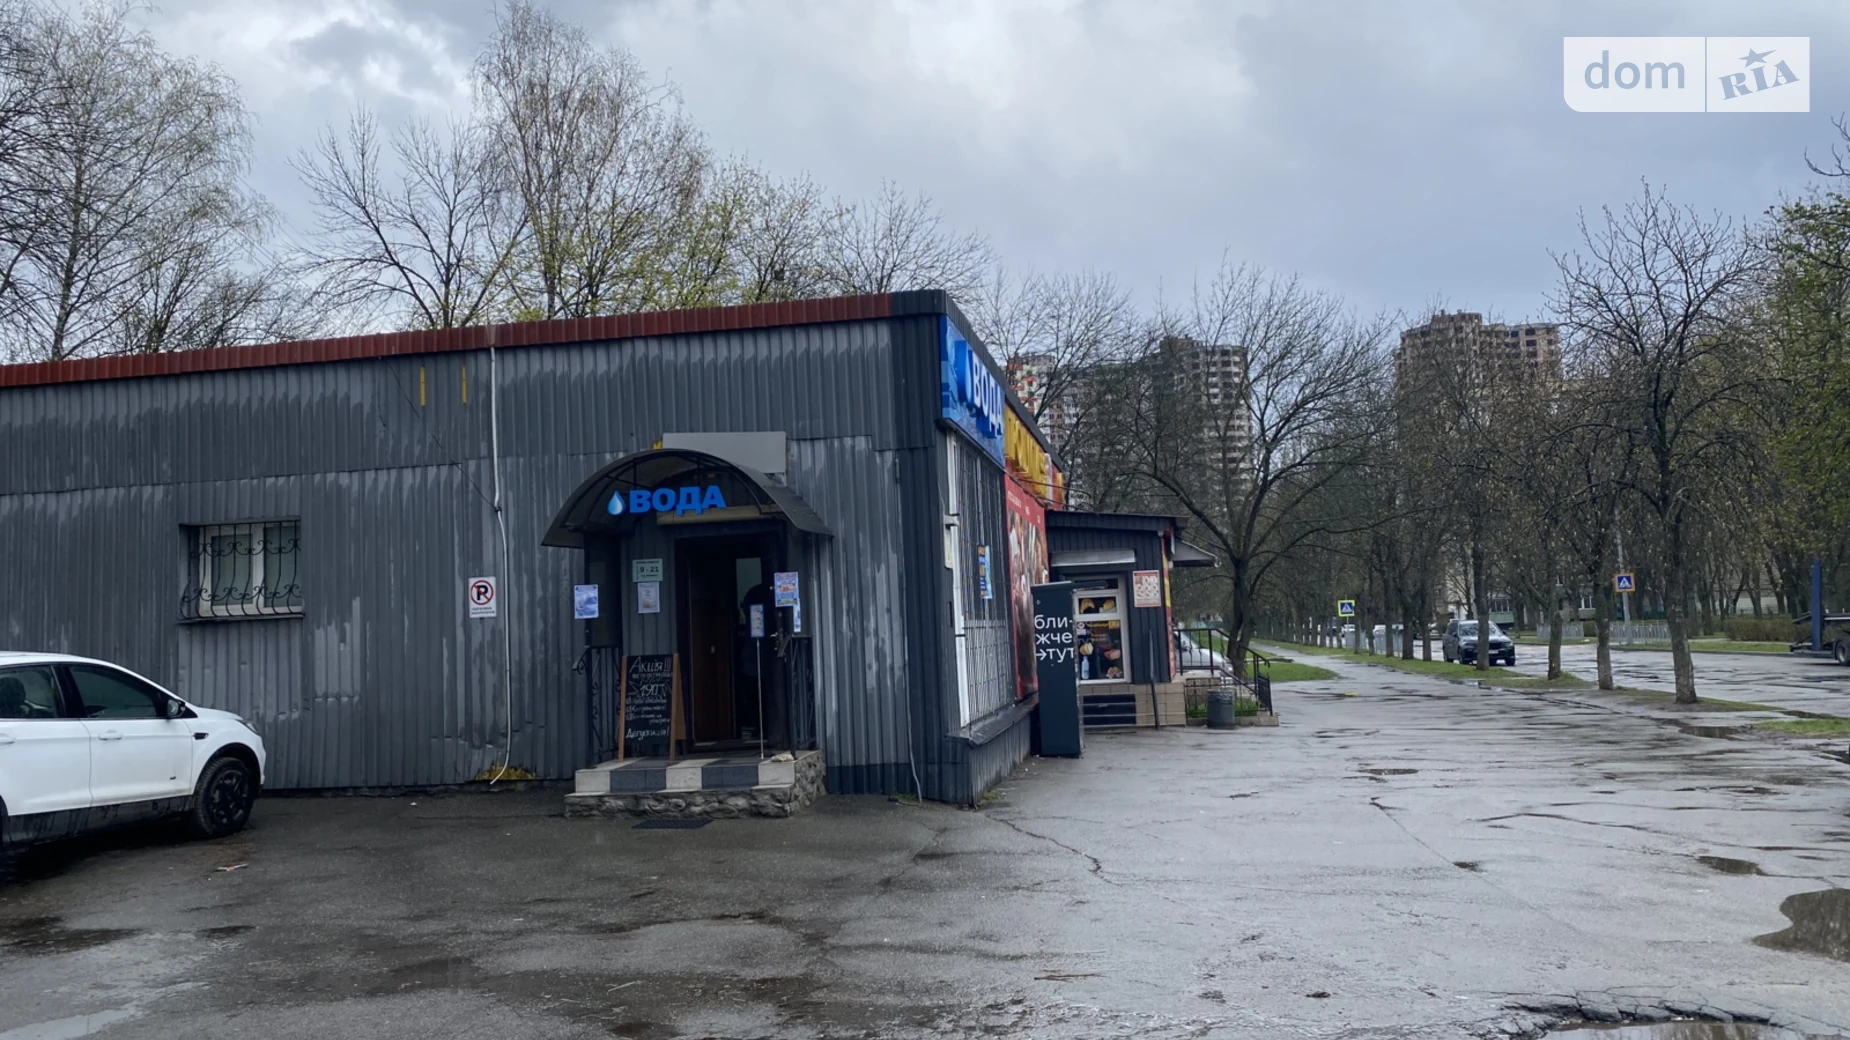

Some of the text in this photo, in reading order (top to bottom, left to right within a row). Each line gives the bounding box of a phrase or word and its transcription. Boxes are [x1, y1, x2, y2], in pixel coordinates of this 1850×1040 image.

[971, 352, 1004, 438] ВОДА
[629, 485, 727, 516] ВОДА
[476, 584, 489, 601] P
[1034, 614, 1073, 629] бли-
[1036, 632, 1072, 644] жче
[1046, 648, 1074, 662] тут
